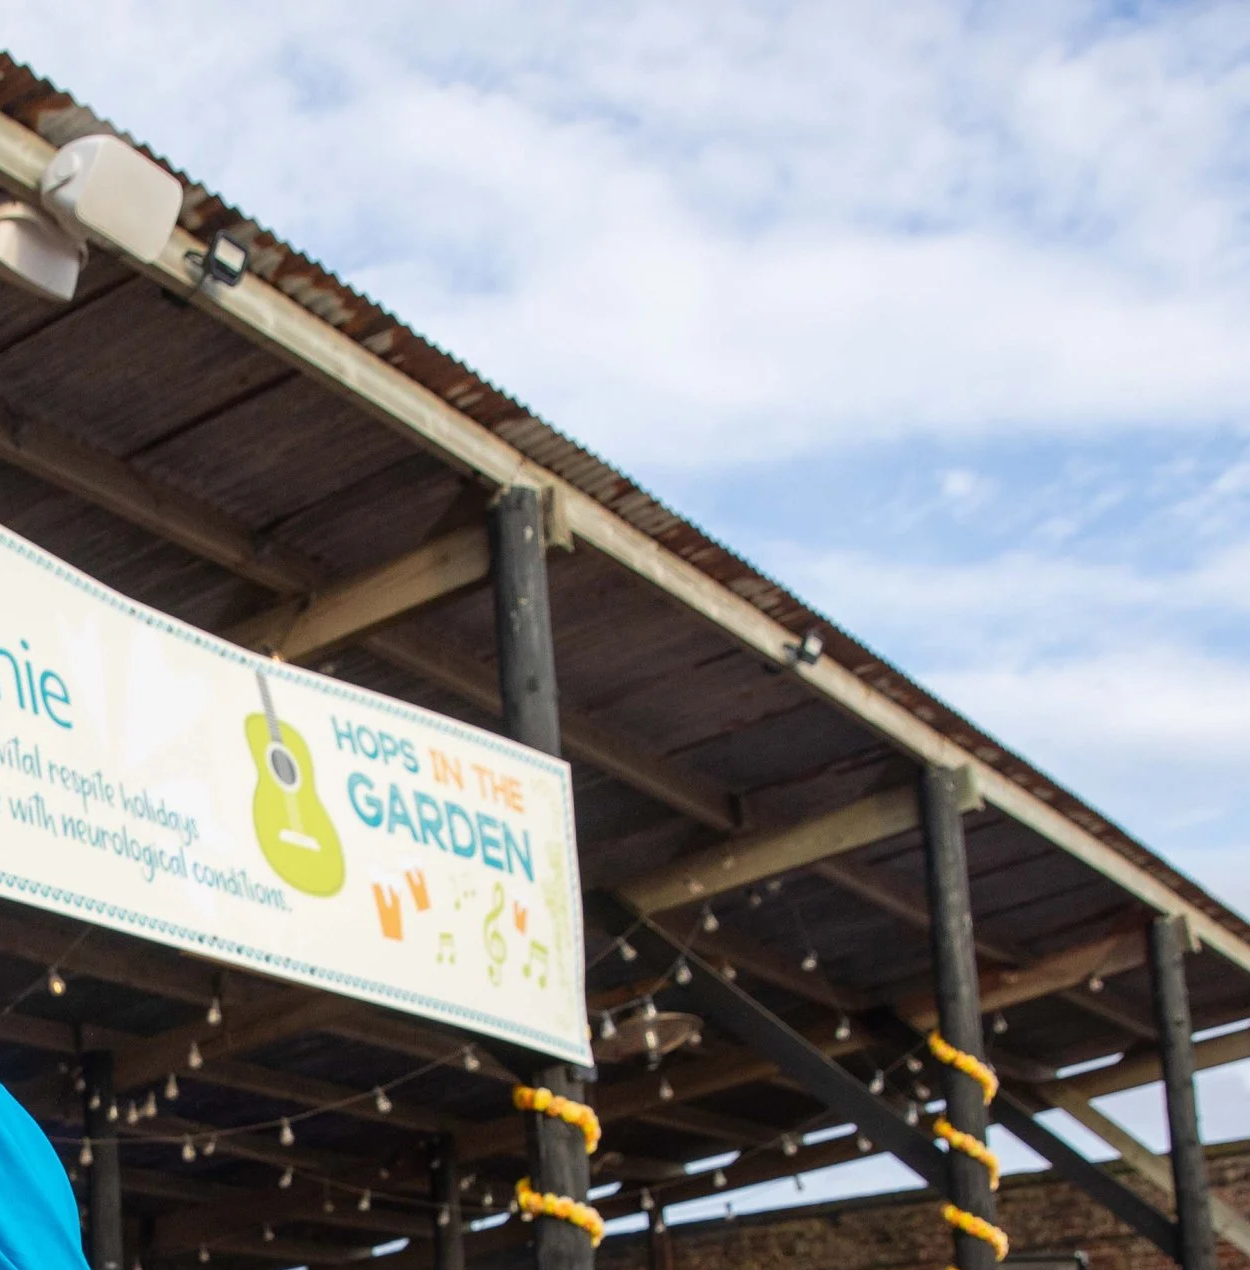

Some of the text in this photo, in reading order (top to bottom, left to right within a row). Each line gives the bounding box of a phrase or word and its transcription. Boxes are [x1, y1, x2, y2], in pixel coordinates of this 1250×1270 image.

[48, 760, 115, 814] respite
[119, 781, 200, 846] holidays
[330, 713, 526, 815] HOPS IN THE
[8, 792, 58, 837] with
[61, 812, 188, 884] neurological
[347, 772, 535, 883] GARDEN
